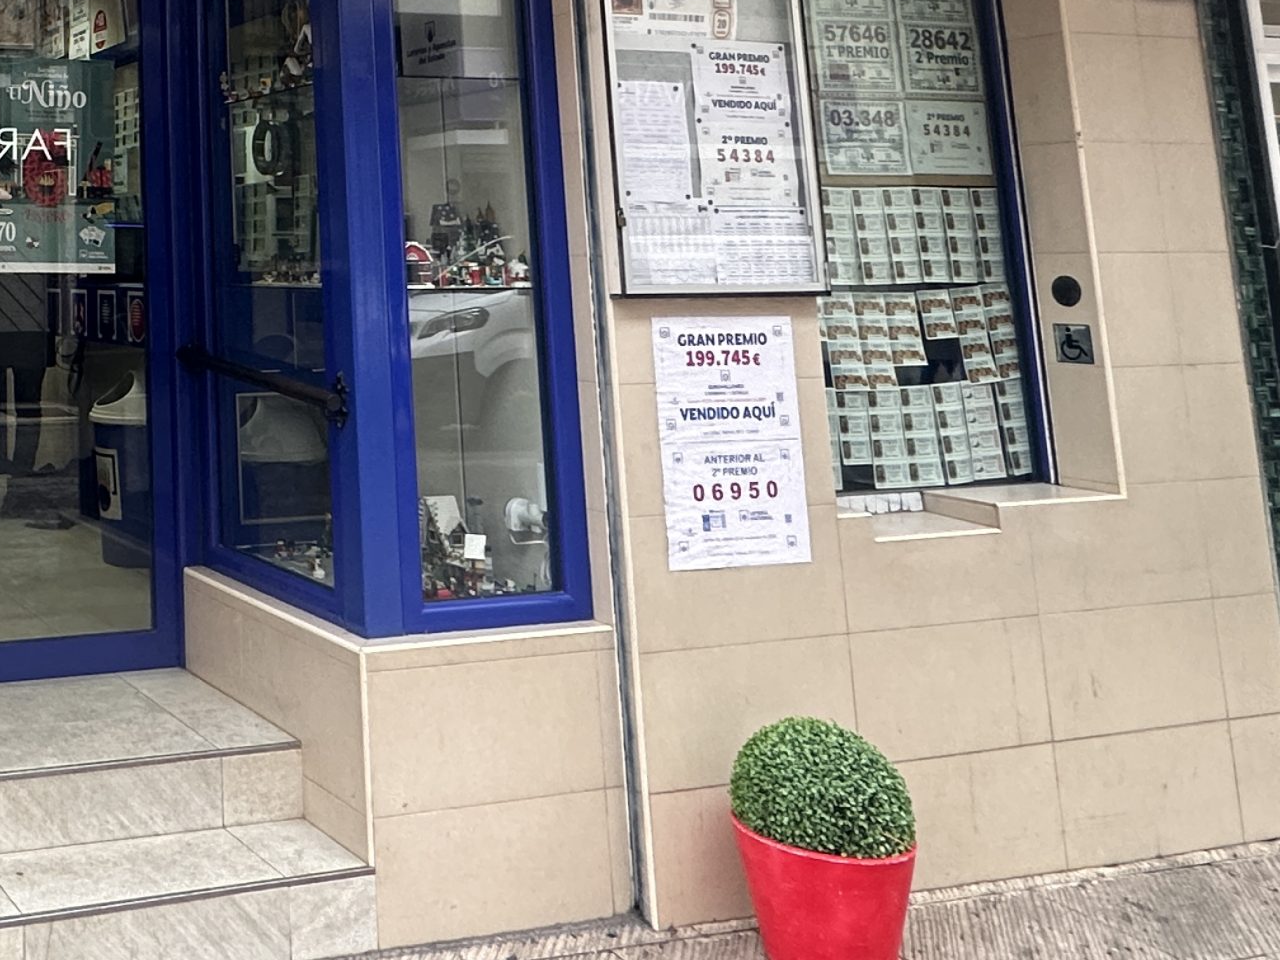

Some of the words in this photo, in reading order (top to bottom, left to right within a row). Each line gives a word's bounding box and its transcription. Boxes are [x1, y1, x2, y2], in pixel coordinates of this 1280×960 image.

[824, 24, 886, 43] 57646
[909, 28, 973, 51] 28642
[708, 52, 735, 61] GRAN
[737, 53, 770, 63] PREMIO
[838, 45, 889, 59] PREMIO
[926, 52, 969, 66] Premio
[21, 79, 87, 111] Niño
[711, 99, 753, 110] VENDIDO
[754, 99, 777, 111] AQUÍ
[830, 109, 896, 127] 03.348
[923, 124, 971, 137] 54384
[735, 136, 768, 145] PREMIO
[717, 148, 775, 163] 54384
[677, 334, 715, 347] GRAN
[717, 333, 767, 346] PREMIO
[685, 349, 761, 367] 199.745€
[679, 406, 740, 421] VENDIDO
[742, 402, 776, 421] AQUÍ
[704, 454, 752, 464] ANTERIOR
[753, 454, 765, 463] AL
[722, 467, 758, 476] PREMIO
[693, 481, 779, 502] 06950
